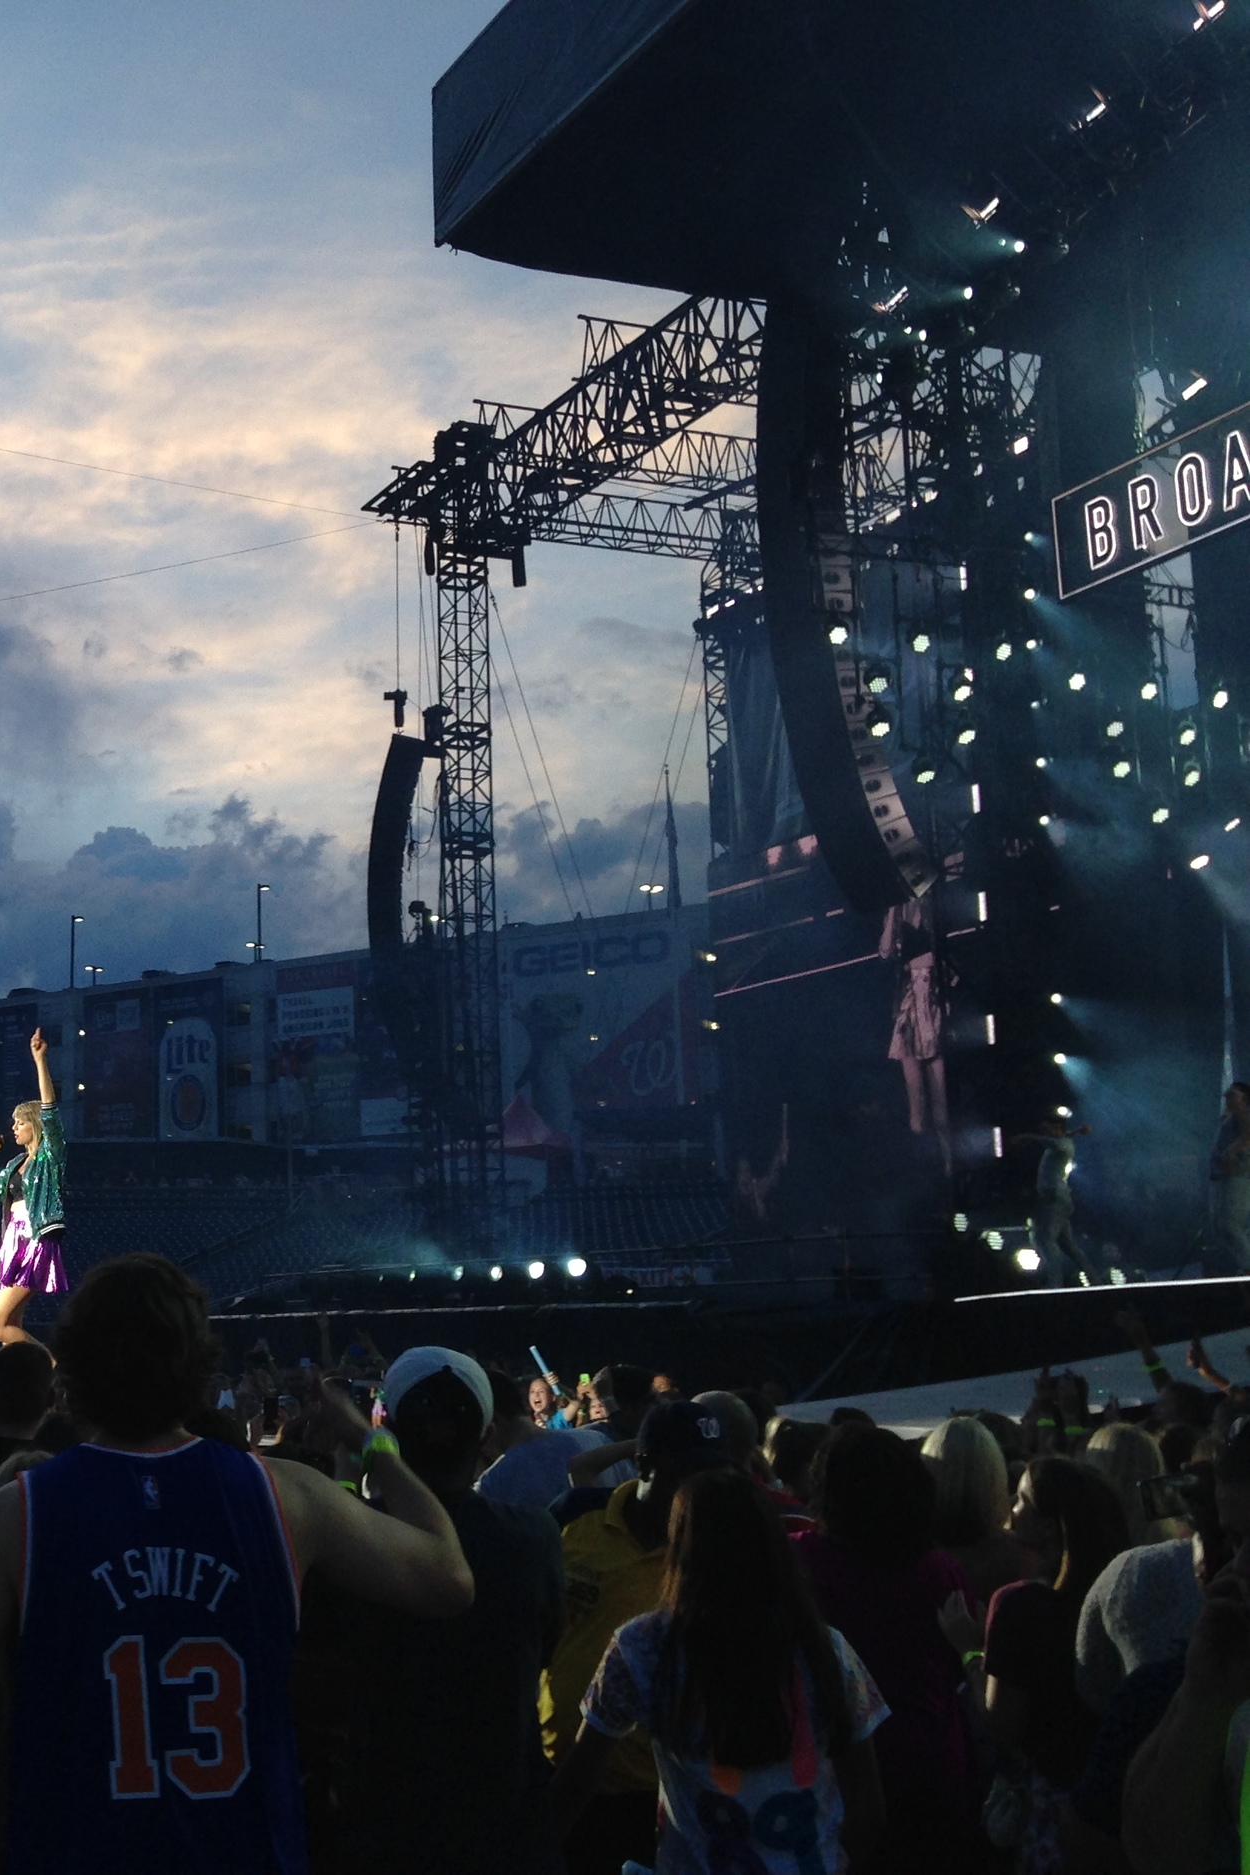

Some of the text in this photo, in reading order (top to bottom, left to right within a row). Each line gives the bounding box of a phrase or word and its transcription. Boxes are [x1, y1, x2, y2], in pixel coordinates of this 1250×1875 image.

[513, 930, 669, 977] GEICO
[166, 1034, 210, 1075] Lite
[102, 1634, 252, 1801] 13
